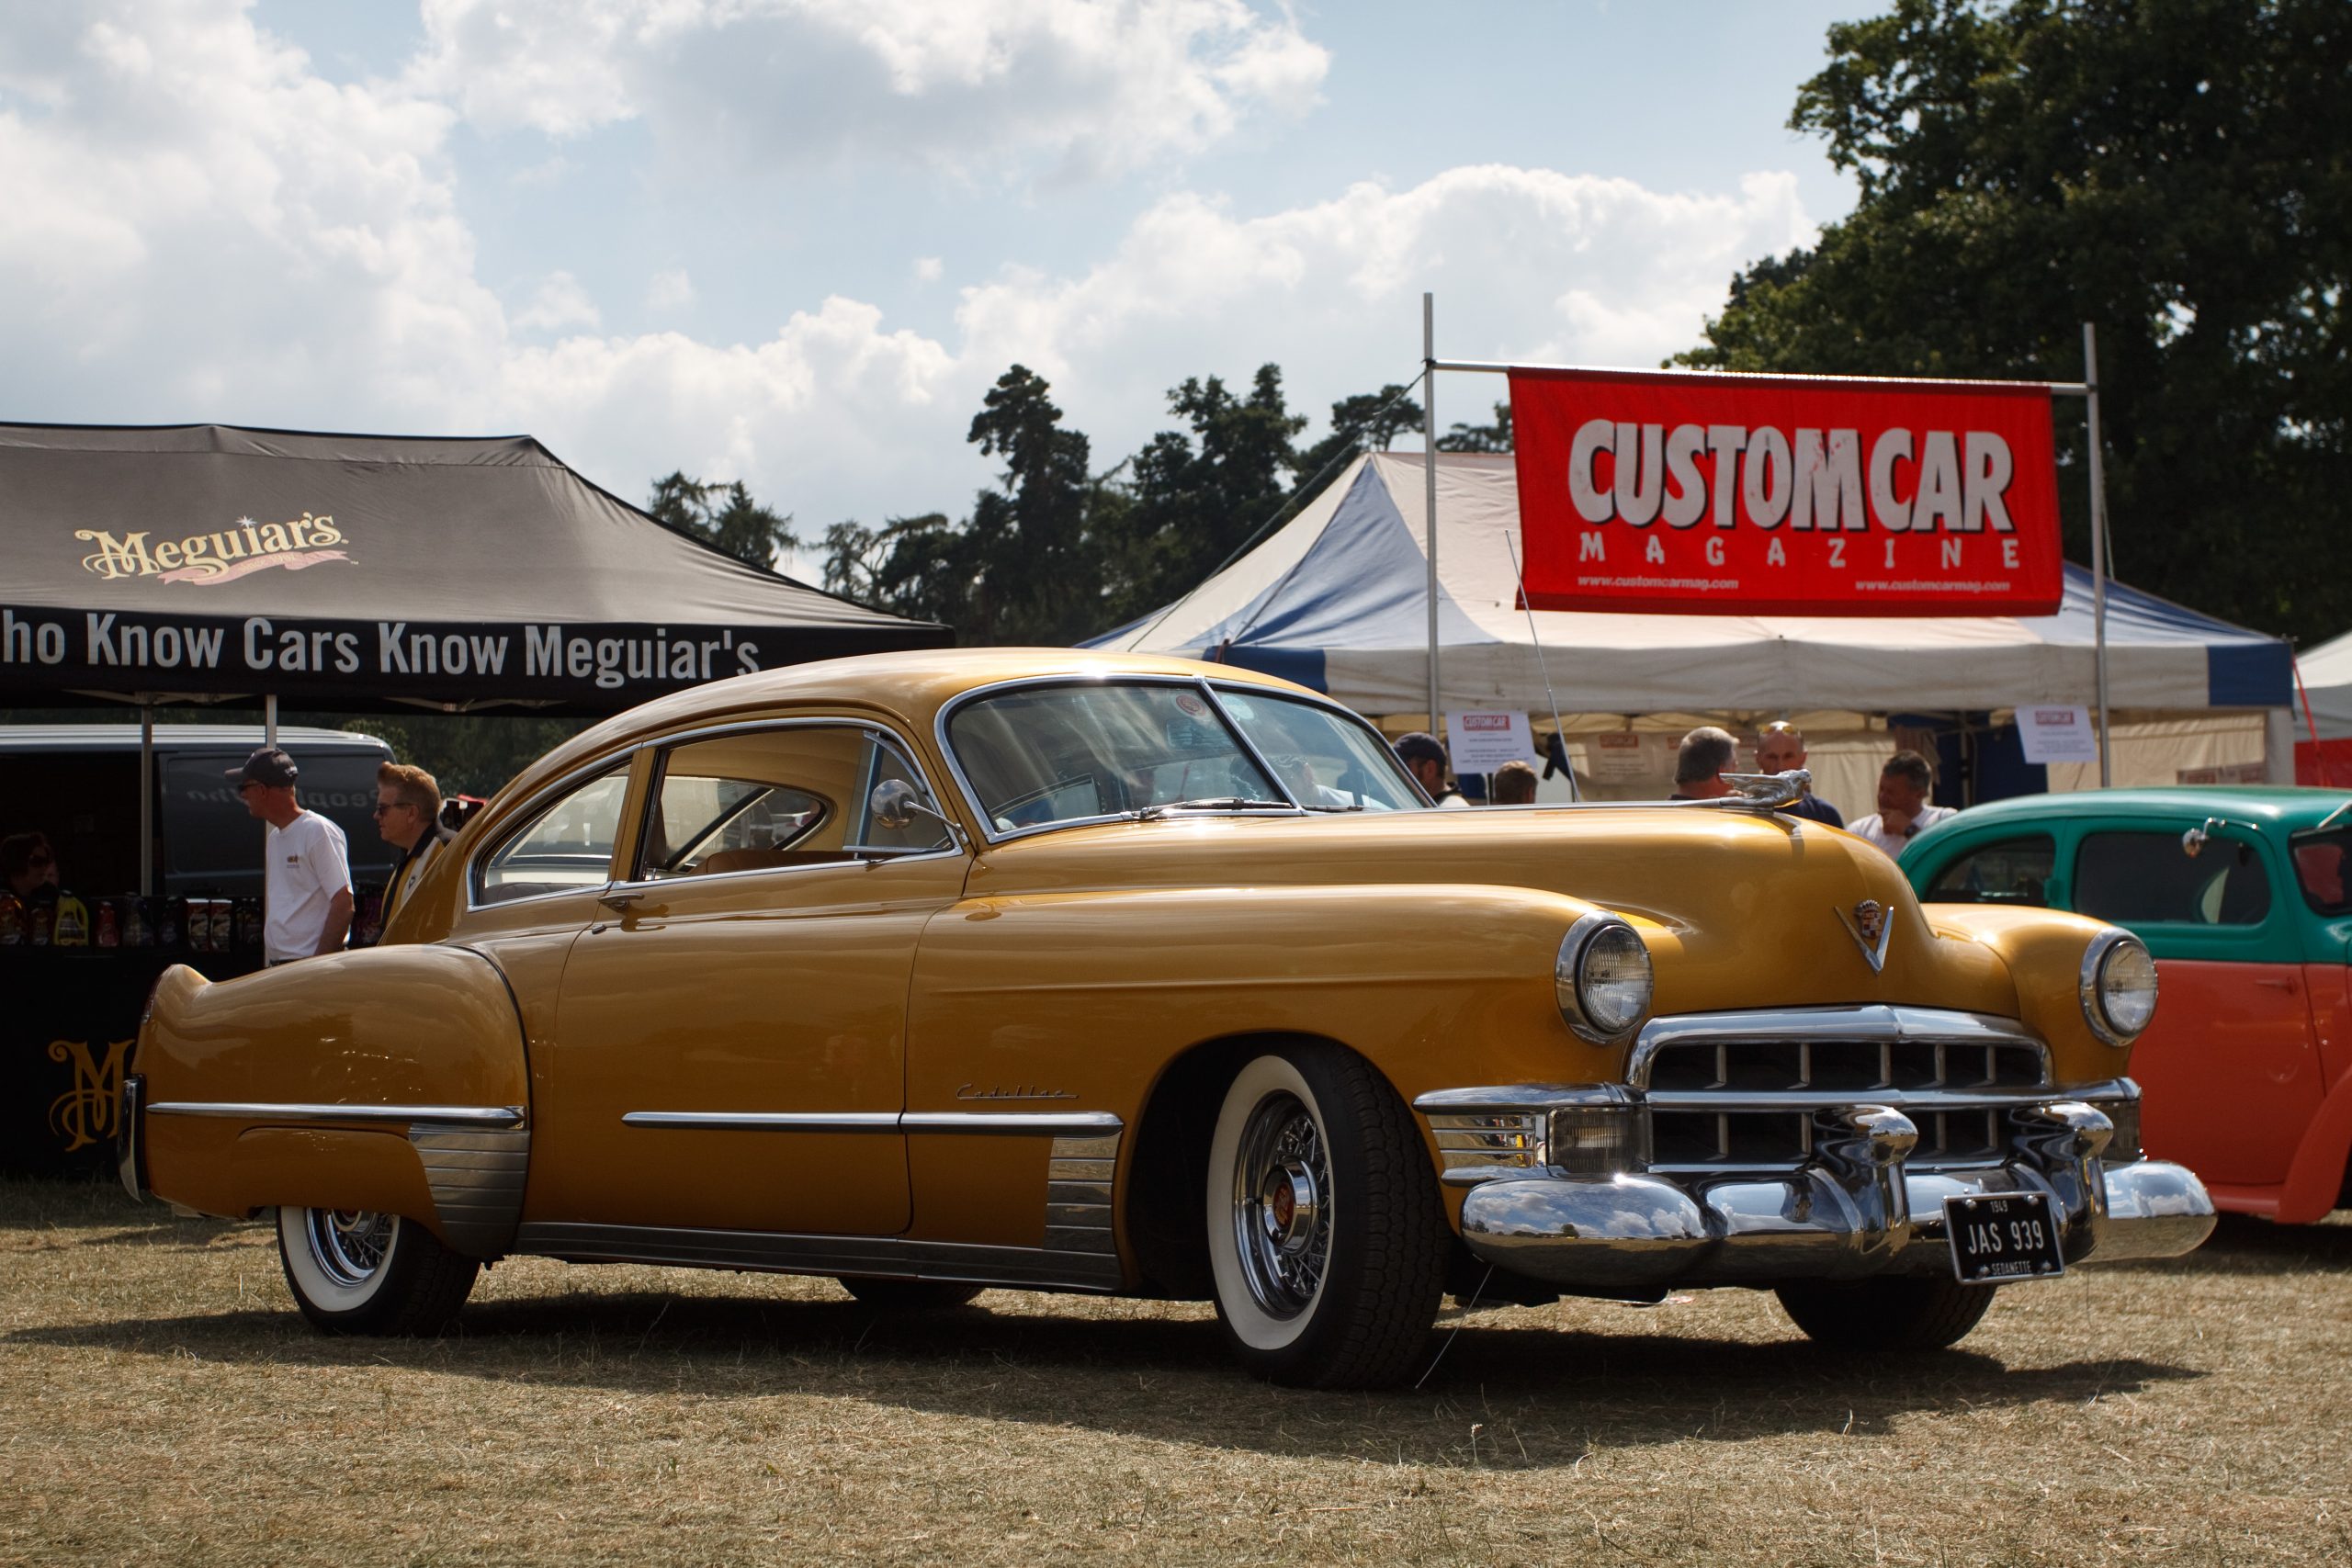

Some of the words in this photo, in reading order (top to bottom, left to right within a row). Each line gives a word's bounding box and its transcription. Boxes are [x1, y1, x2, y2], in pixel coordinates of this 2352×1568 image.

[1567, 418, 2015, 533] CUSTOMCAR
[74, 512, 342, 581] Meguiar's
[1579, 532, 2019, 570] MAGAZINE
[1577, 575, 1739, 592] www.customcarmag.com
[1855, 579, 2010, 593] www.customcarmag.com
[86, 613, 224, 669] Know
[243, 616, 360, 673] Cars
[378, 622, 508, 675] Know
[524, 625, 760, 689] Meguiar's
[1990, 1200, 2008, 1213] 1949
[1968, 1222, 2002, 1255] JAS
[2010, 1220, 2044, 1251] 939
